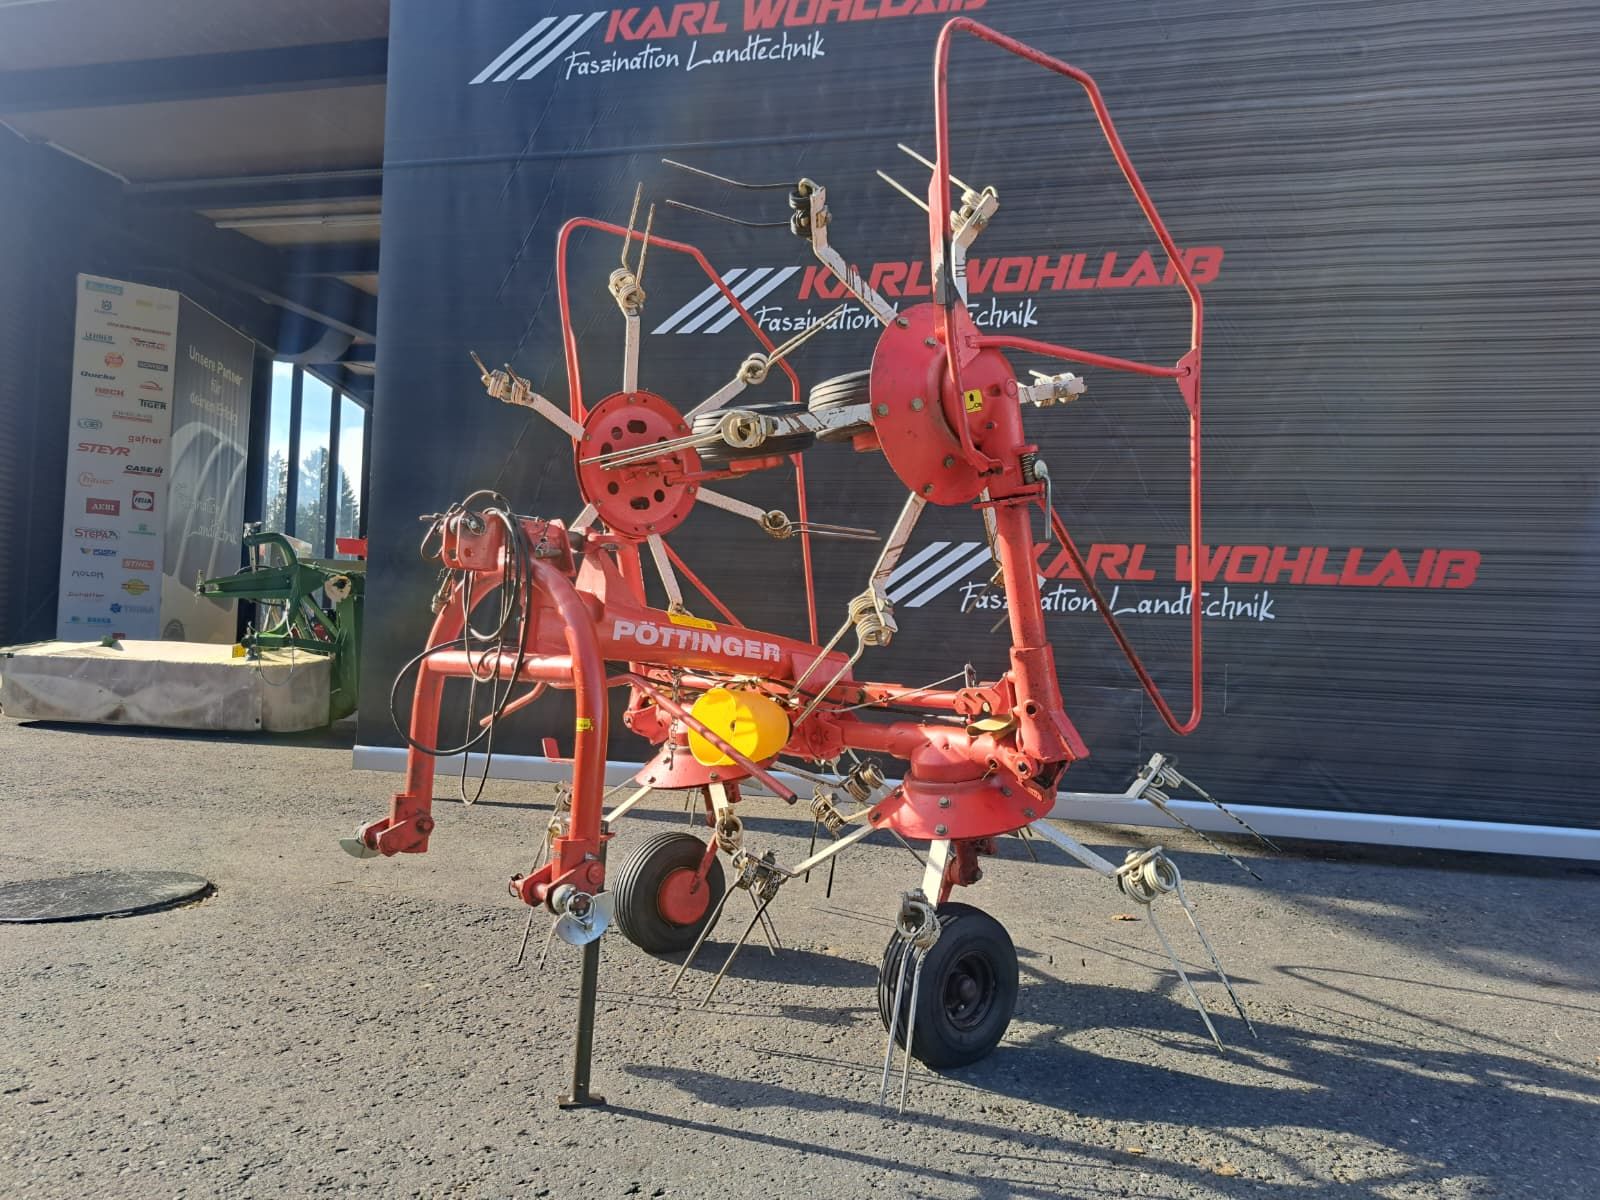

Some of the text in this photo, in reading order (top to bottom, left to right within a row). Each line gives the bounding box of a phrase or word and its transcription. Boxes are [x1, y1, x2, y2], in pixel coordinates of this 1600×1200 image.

[604, 1, 728, 43] KARL
[564, 30, 825, 80] Faszination Landtechnik
[138, 398, 168, 410] TIGER
[128, 435, 163, 445] gafner
[76, 442, 131, 456] STEYR
[125, 464, 153, 473] CASE
[612, 620, 781, 662] PÖTTINGER
